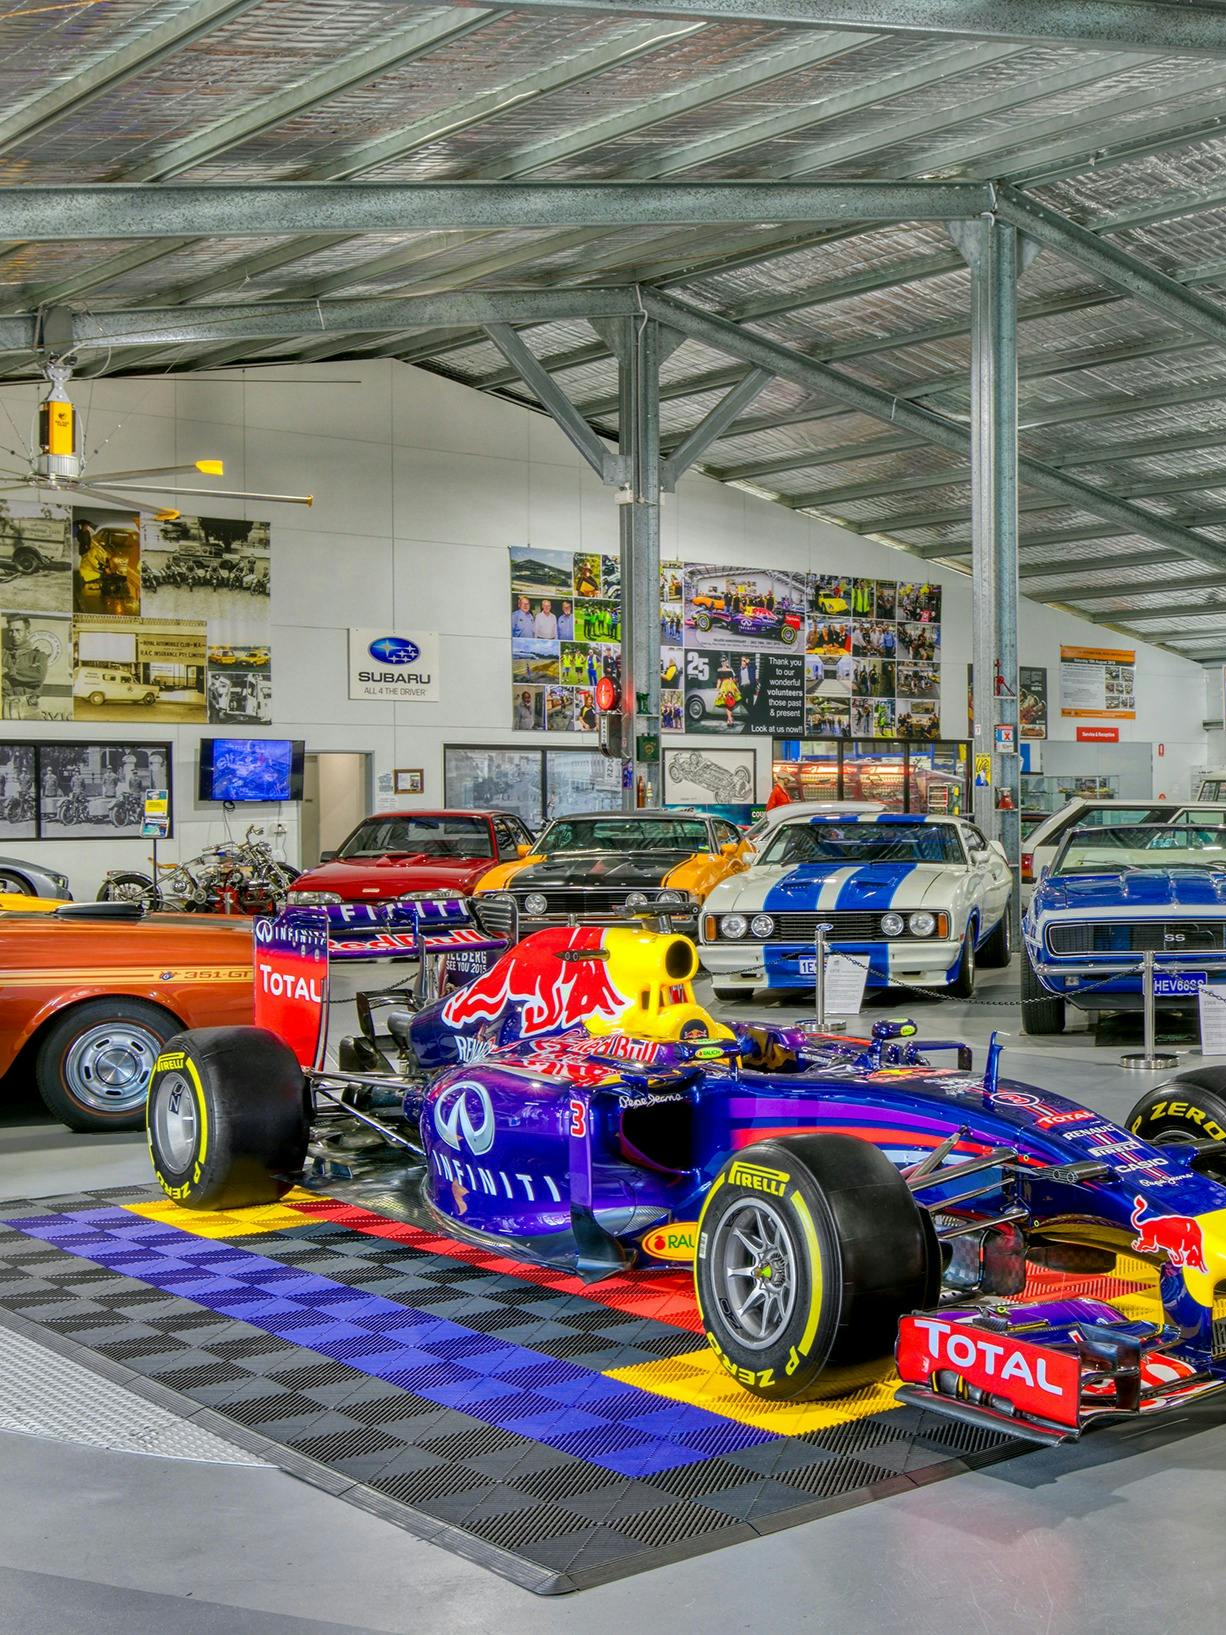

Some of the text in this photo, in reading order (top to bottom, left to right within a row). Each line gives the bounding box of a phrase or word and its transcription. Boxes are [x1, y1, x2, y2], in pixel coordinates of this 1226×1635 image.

[686, 651, 709, 681] 25
[768, 656, 802, 667] Thank you
[358, 672, 431, 684] SUBARU
[776, 668, 783, 676] to
[364, 687, 426, 696] ALL 4 THE DRIVER
[769, 679, 801, 687] wonderful
[767, 688, 803, 697] volunteers
[768, 699, 802, 708] those past
[751, 725, 768, 733] Look
[309, 900, 469, 923] NFINITI
[275, 927, 328, 945] INFINITI
[1164, 933, 1186, 942] SS
[446, 960, 487, 974] SEE YOU 2015
[260, 964, 322, 1003] TOTAL
[612, 1035, 660, 1064] Bull
[157, 1052, 186, 1072] PIRELLI
[619, 1093, 683, 1109] Pepe Jeans
[570, 1100, 586, 1138] 3
[1041, 1110, 1097, 1127] TOTAL
[1062, 1123, 1116, 1141] RENAULT
[1088, 1140, 1144, 1157] PIRELLI
[1114, 1157, 1169, 1174] CASIO
[432, 1149, 561, 1203] INFINITI
[728, 1160, 791, 1198] PIRELLI
[156, 1170, 192, 1200] ZERO
[667, 1234, 696, 1249] RAU
[706, 1331, 801, 1389] P ZERO
[914, 1319, 1064, 1396] TOTAL
